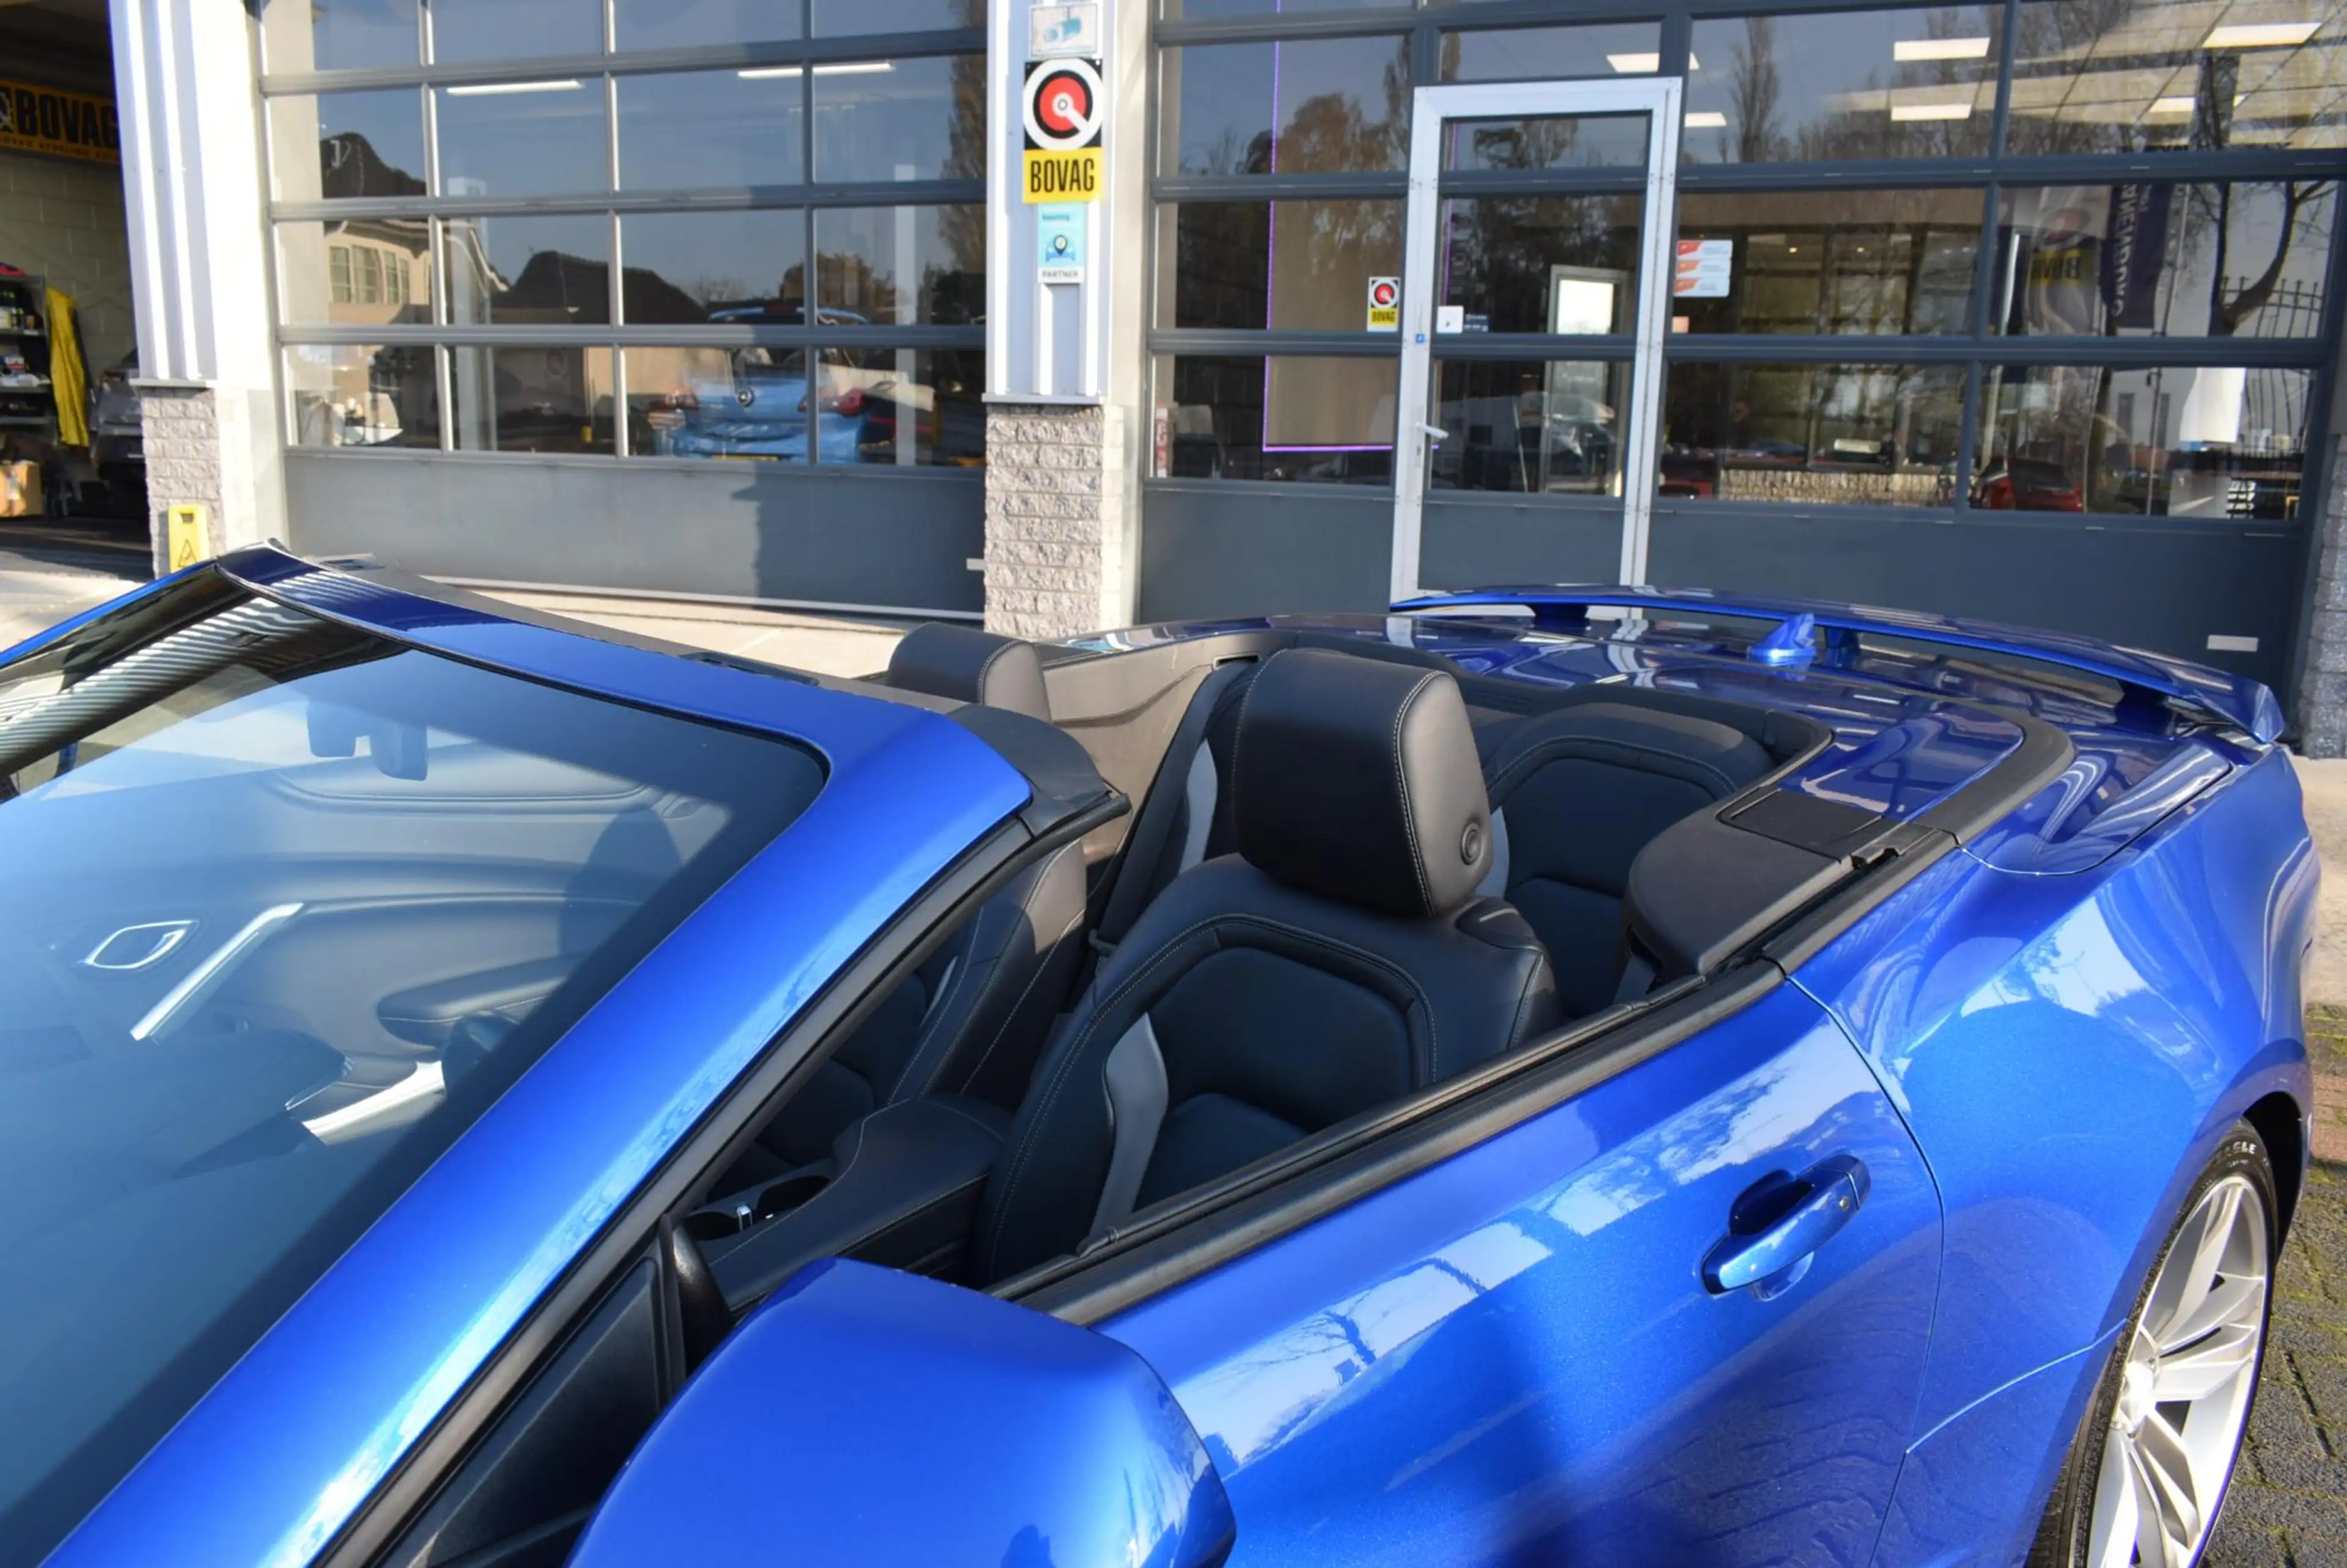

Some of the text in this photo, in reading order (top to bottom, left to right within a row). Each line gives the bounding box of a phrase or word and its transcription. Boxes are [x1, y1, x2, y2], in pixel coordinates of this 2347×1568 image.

[15, 89, 119, 150] BOVAG
[1030, 158, 1095, 193] BOVAG
[1372, 310, 1395, 323] BOVAG
